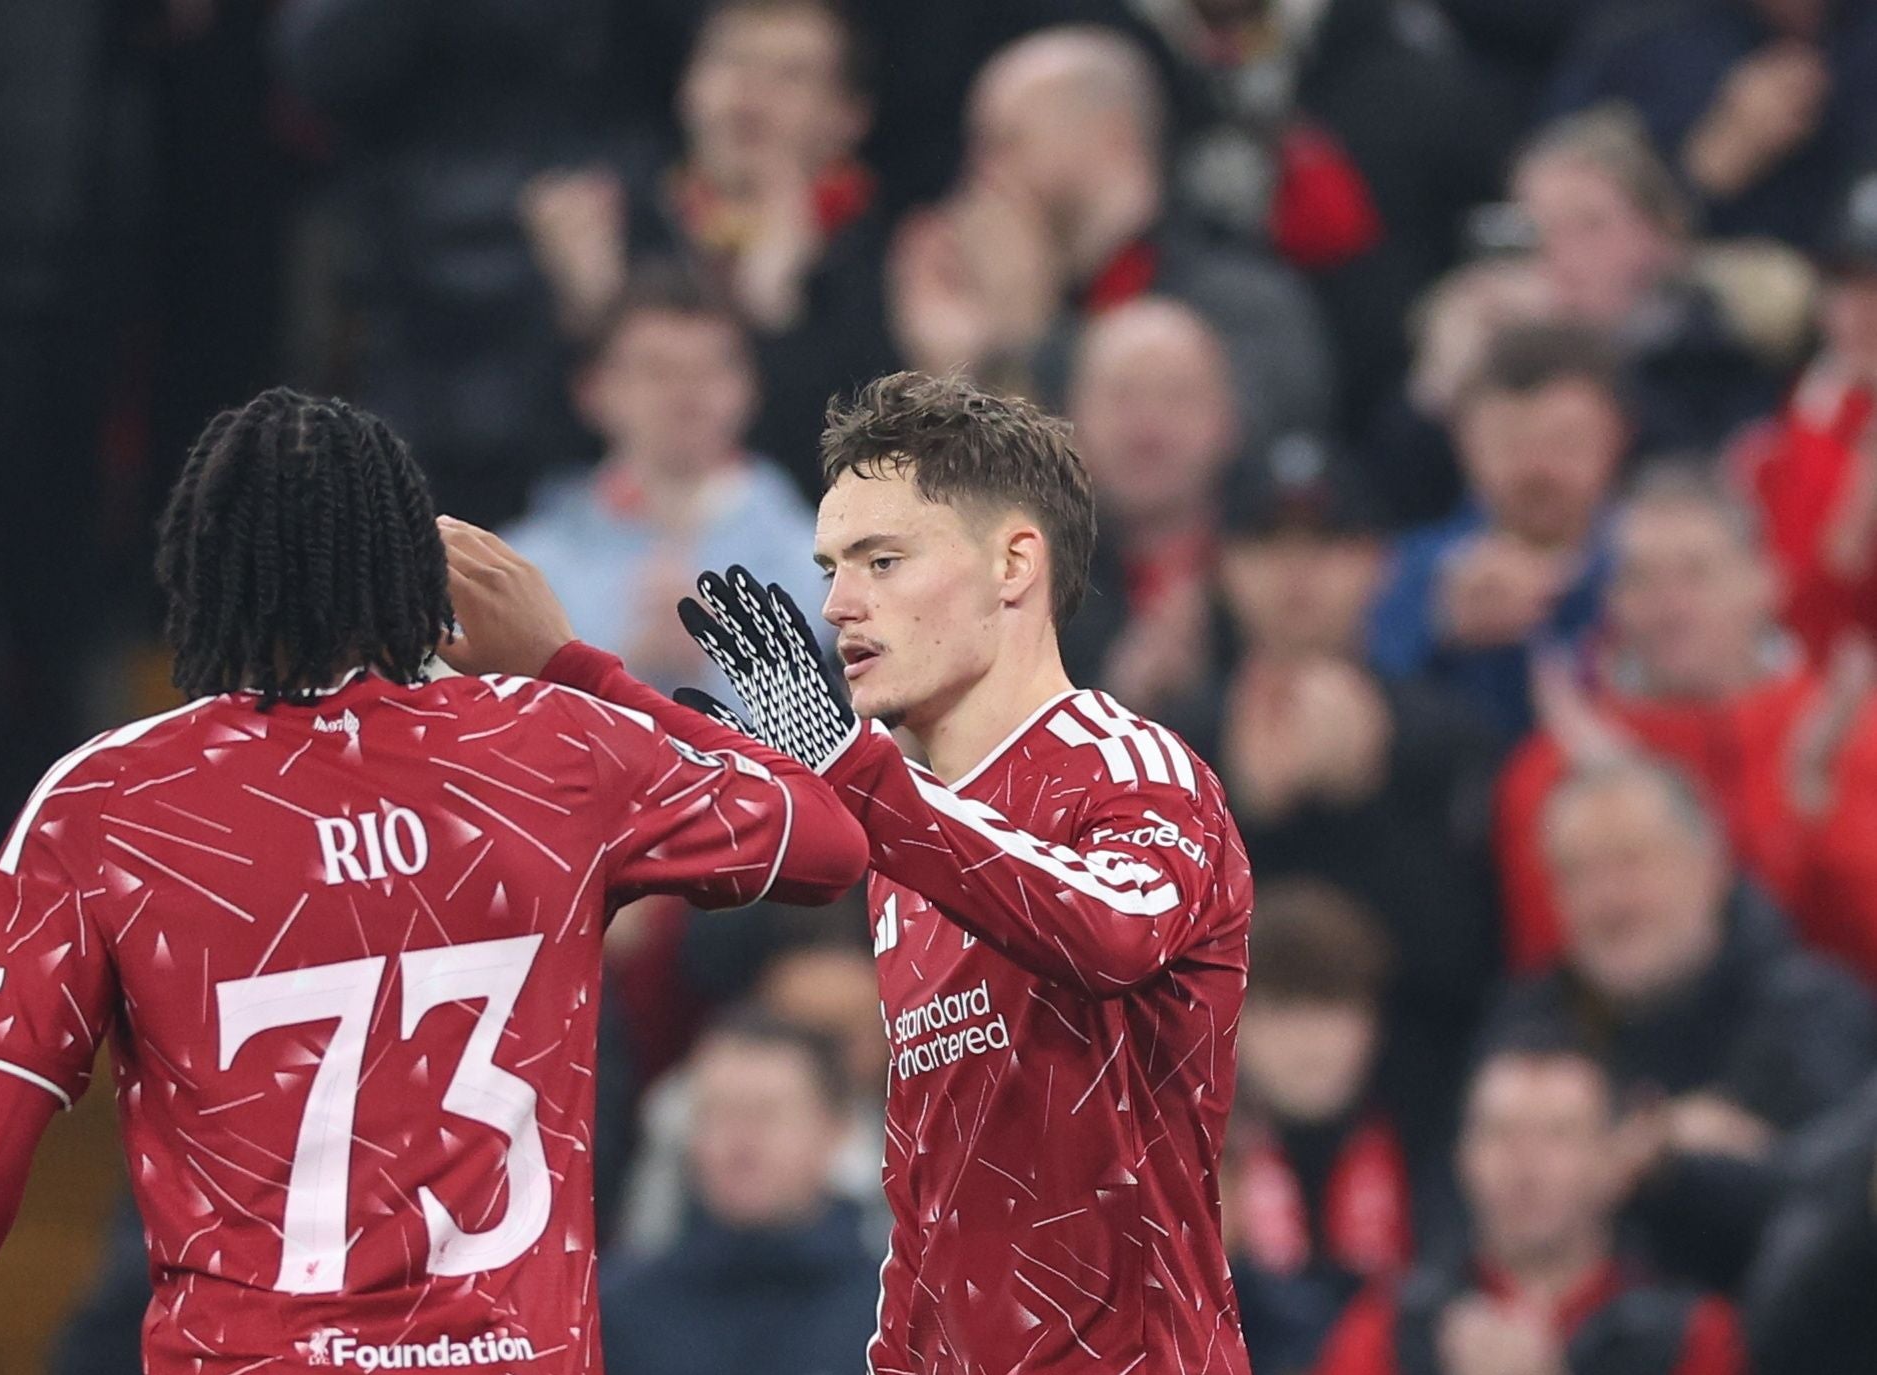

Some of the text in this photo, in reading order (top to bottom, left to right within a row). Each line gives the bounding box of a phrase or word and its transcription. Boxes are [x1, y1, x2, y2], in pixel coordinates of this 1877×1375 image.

[314, 807, 428, 885] RIO
[895, 978, 991, 1044] standard
[898, 1013, 1010, 1081] chartered
[216, 933, 553, 1293] 73
[332, 1331, 535, 1369] Foundation
